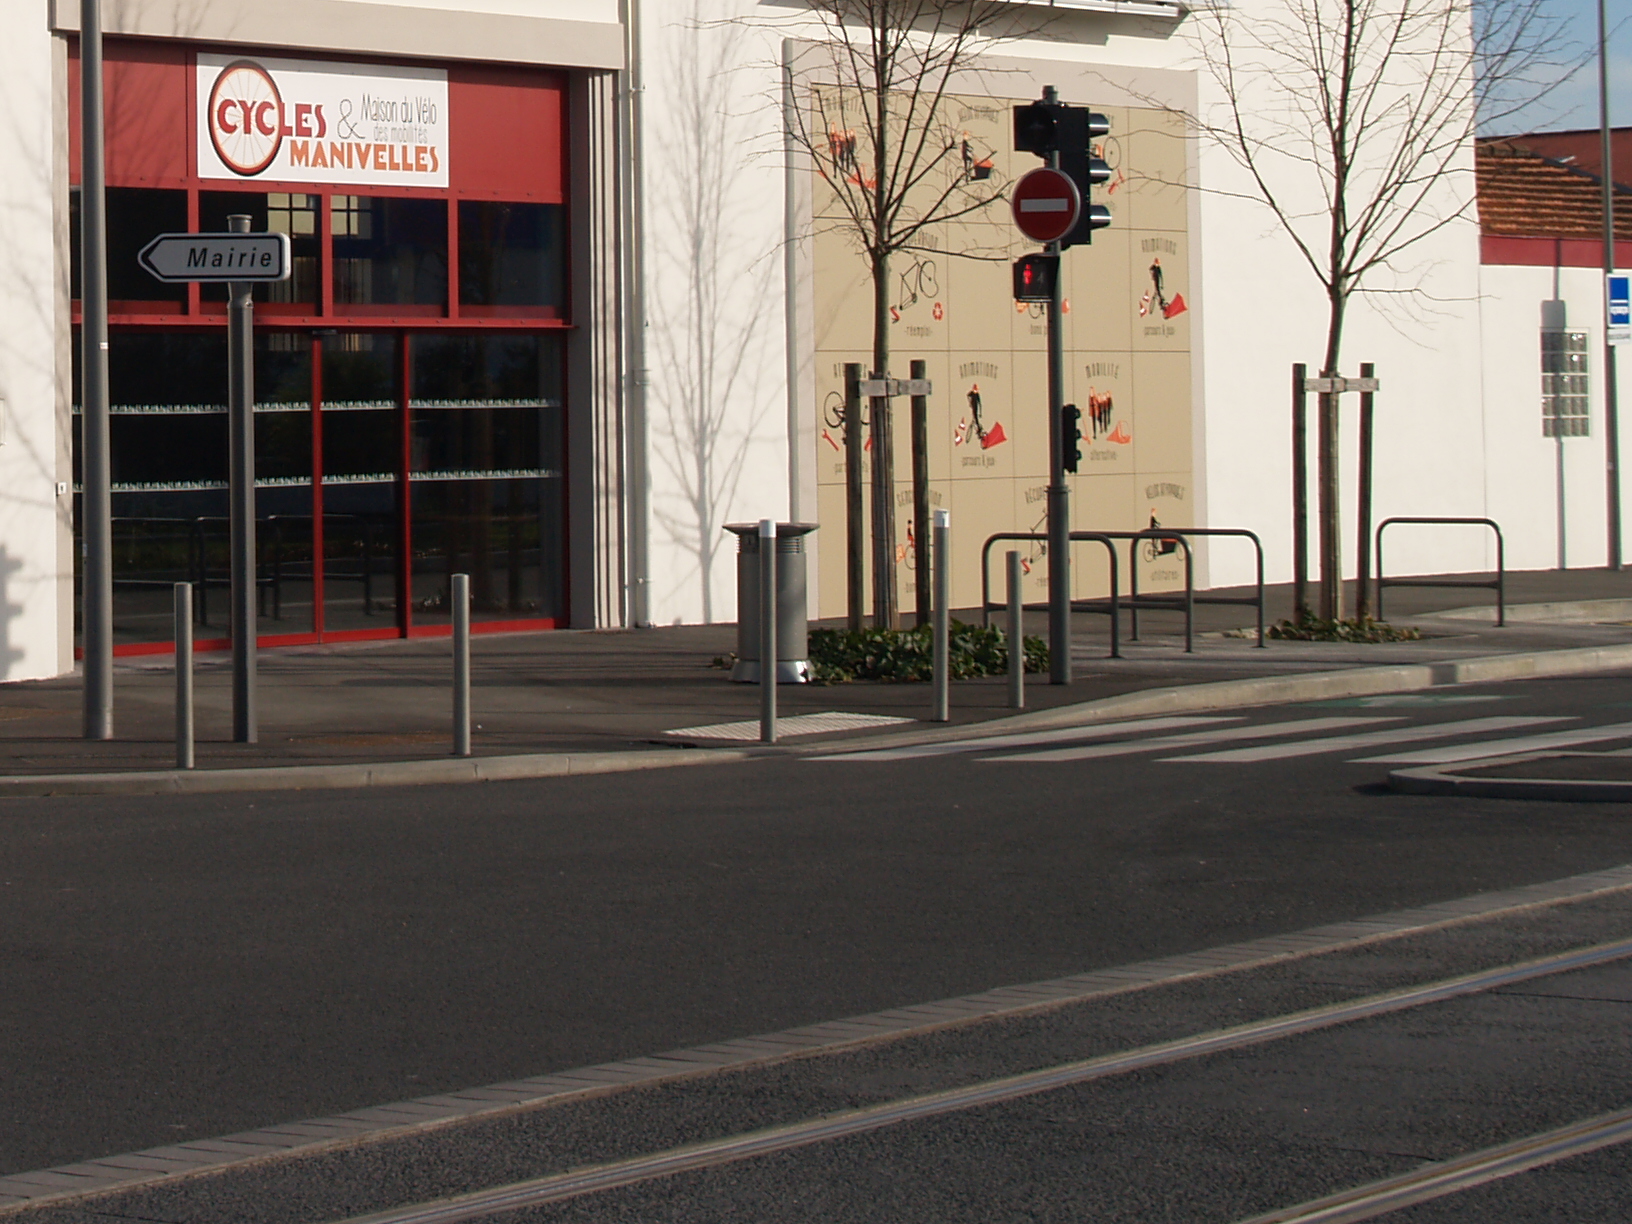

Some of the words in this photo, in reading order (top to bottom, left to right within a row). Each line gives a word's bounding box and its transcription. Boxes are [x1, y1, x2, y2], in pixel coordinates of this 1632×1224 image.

[217, 98, 326, 138] CYCLES
[337, 98, 366, 140] &
[360, 93, 398, 122] Maison
[400, 95, 413, 123] du
[415, 96, 437, 125] Vélo
[373, 123, 388, 142] des
[289, 139, 439, 173] MANIVELLES
[187, 246, 272, 268] Mairie
